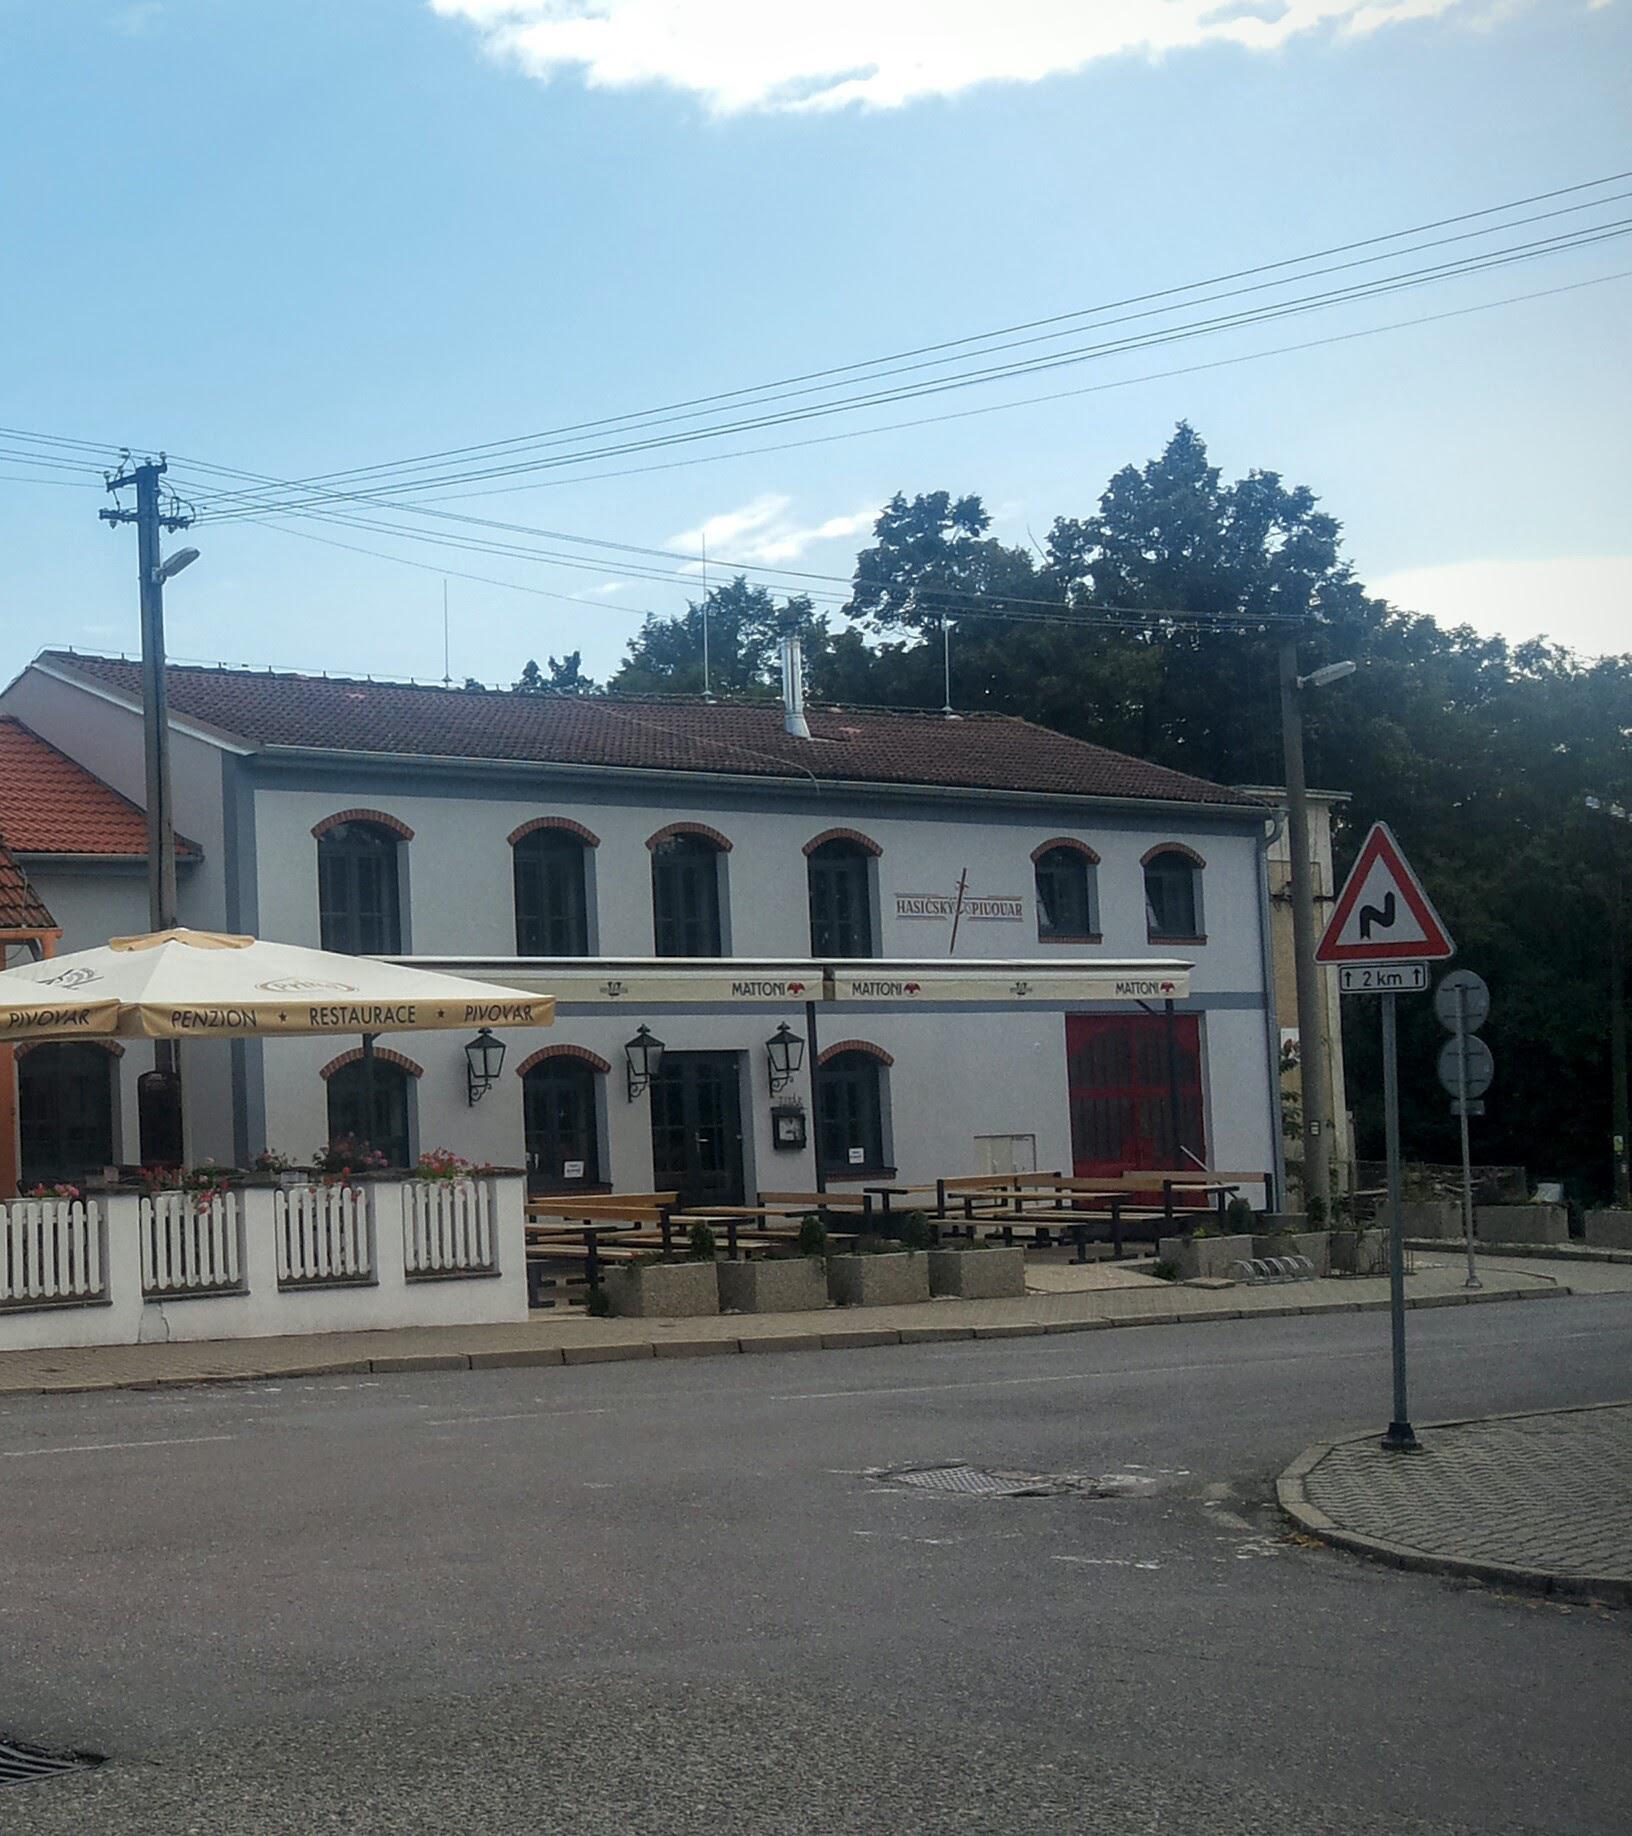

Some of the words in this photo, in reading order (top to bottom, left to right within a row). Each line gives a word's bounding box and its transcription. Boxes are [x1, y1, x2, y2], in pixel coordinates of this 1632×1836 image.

[1363, 970, 1372, 987] 2
[1376, 970, 1403, 986] km
[731, 981, 785, 997] MATTONI
[851, 981, 902, 996] MATTONI
[1115, 981, 1159, 995] MATTONI
[7, 1008, 92, 1029] PIVOVAR
[171, 1009, 257, 1029] PENZION
[309, 1005, 416, 1025] RESTAURACE
[464, 1003, 534, 1023] PIVOVAR
